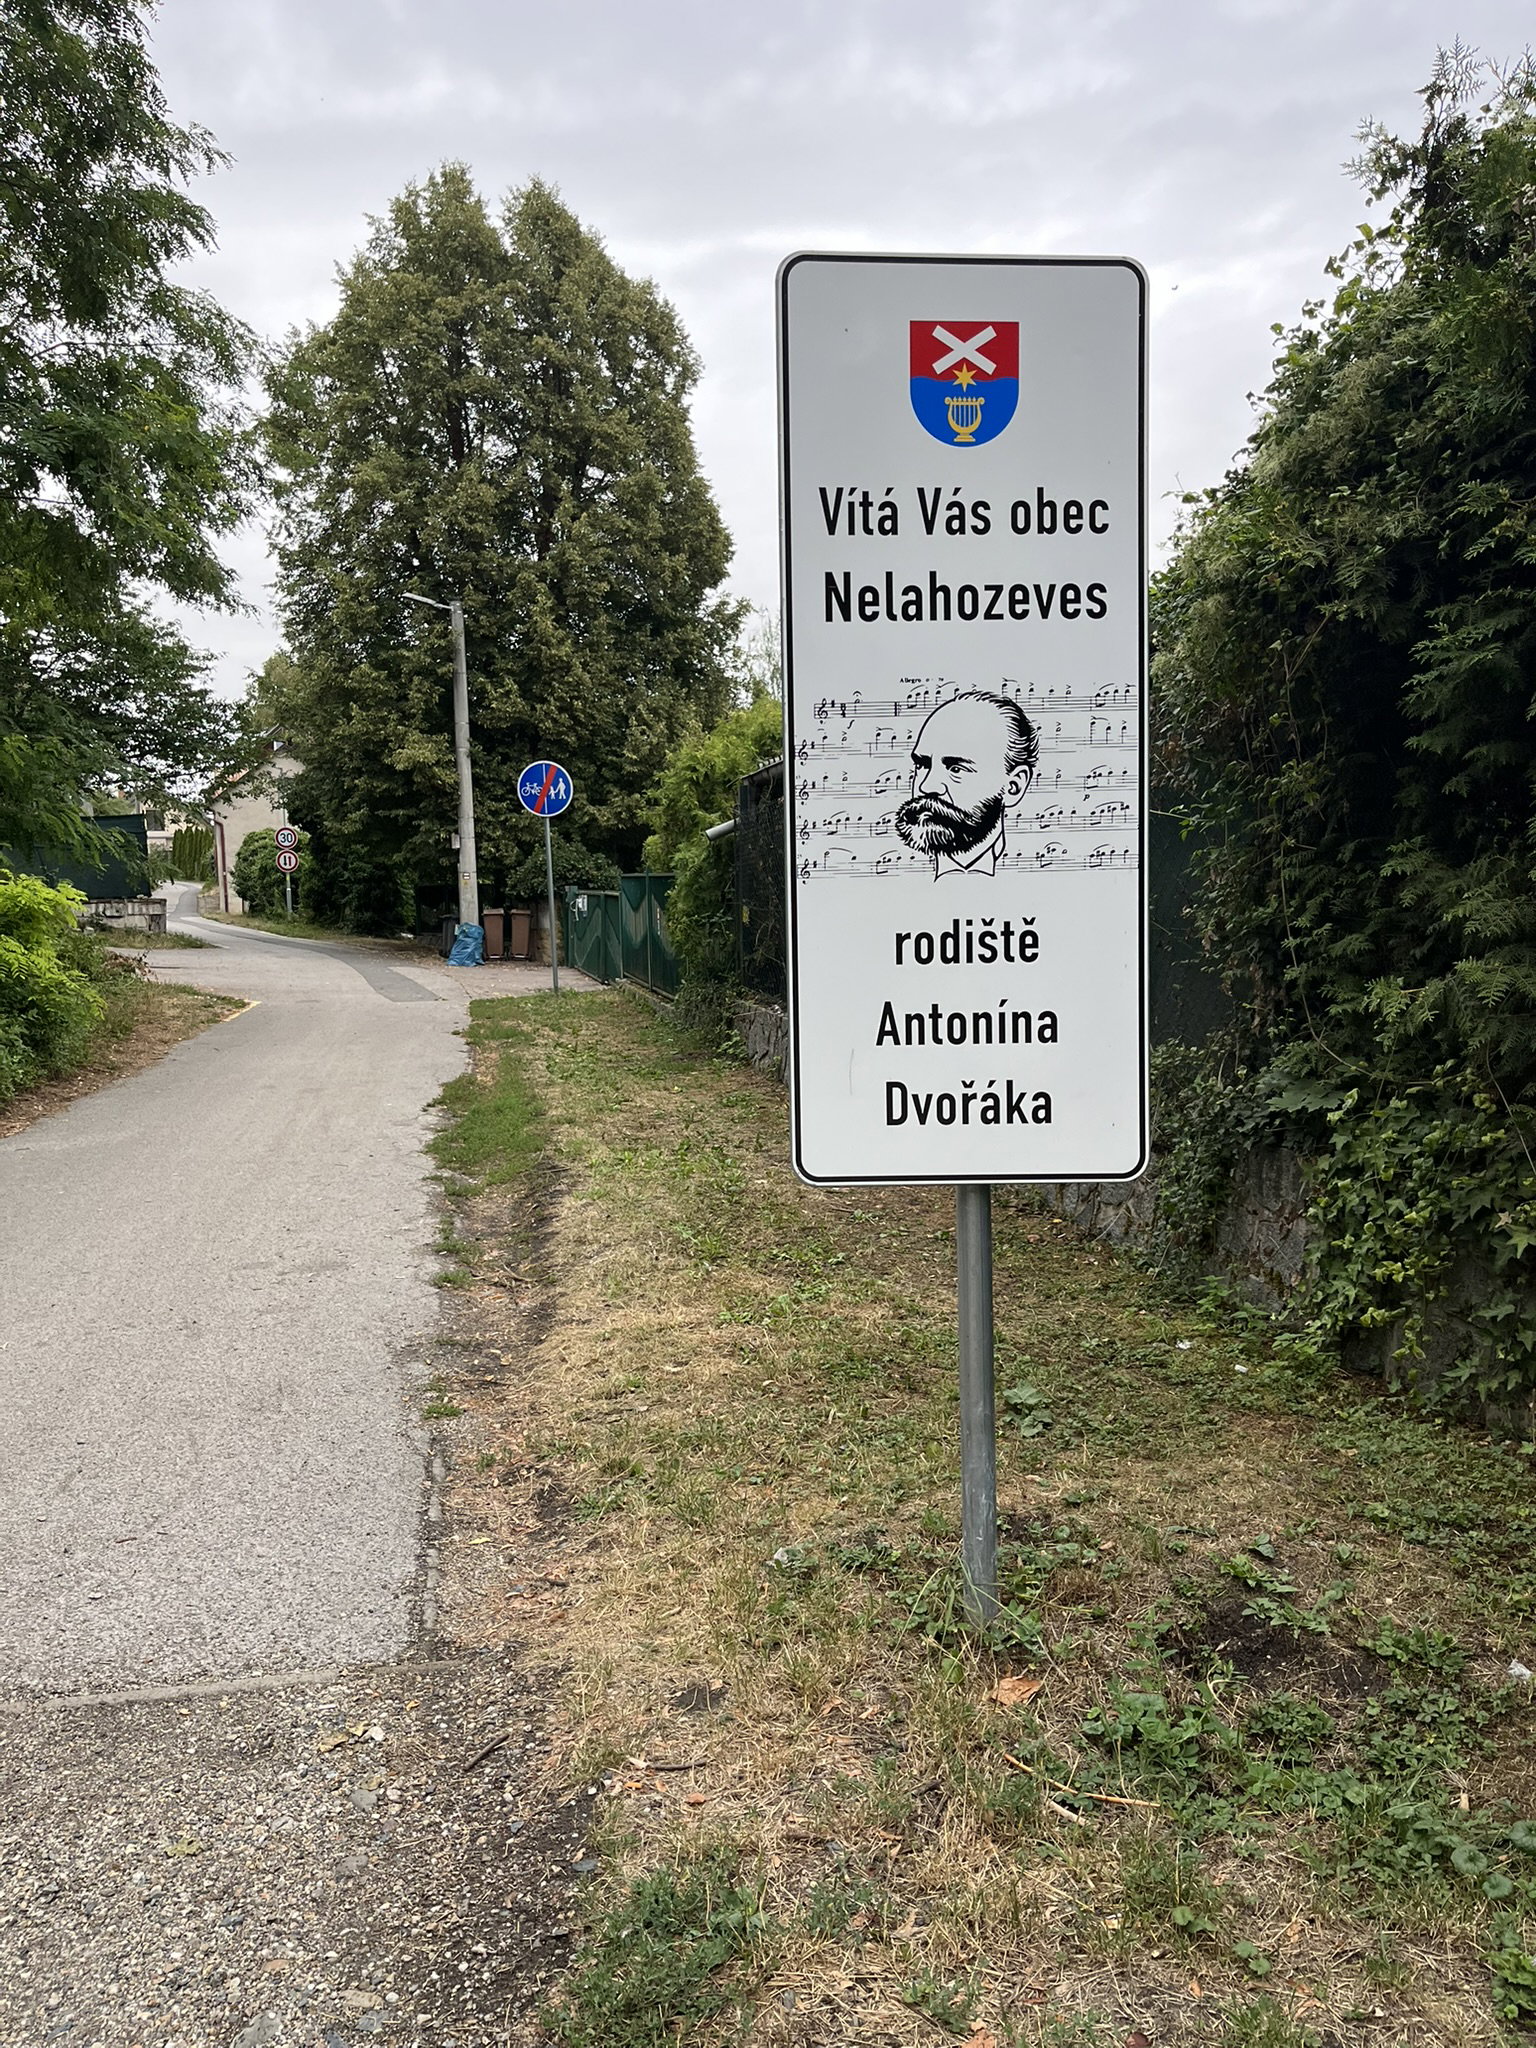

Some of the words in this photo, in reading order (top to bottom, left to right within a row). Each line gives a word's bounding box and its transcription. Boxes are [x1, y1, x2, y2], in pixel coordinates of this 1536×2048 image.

[819, 487, 899, 536] Vítá
[917, 487, 991, 536] Vás
[1010, 487, 1109, 535] obec
[824, 571, 1108, 622] Nelahozeves
[280, 833, 293, 843] 30
[895, 917, 1040, 965] rodiště
[876, 999, 1058, 1046] Antonína
[886, 1080, 1052, 1126] Dvořáka
